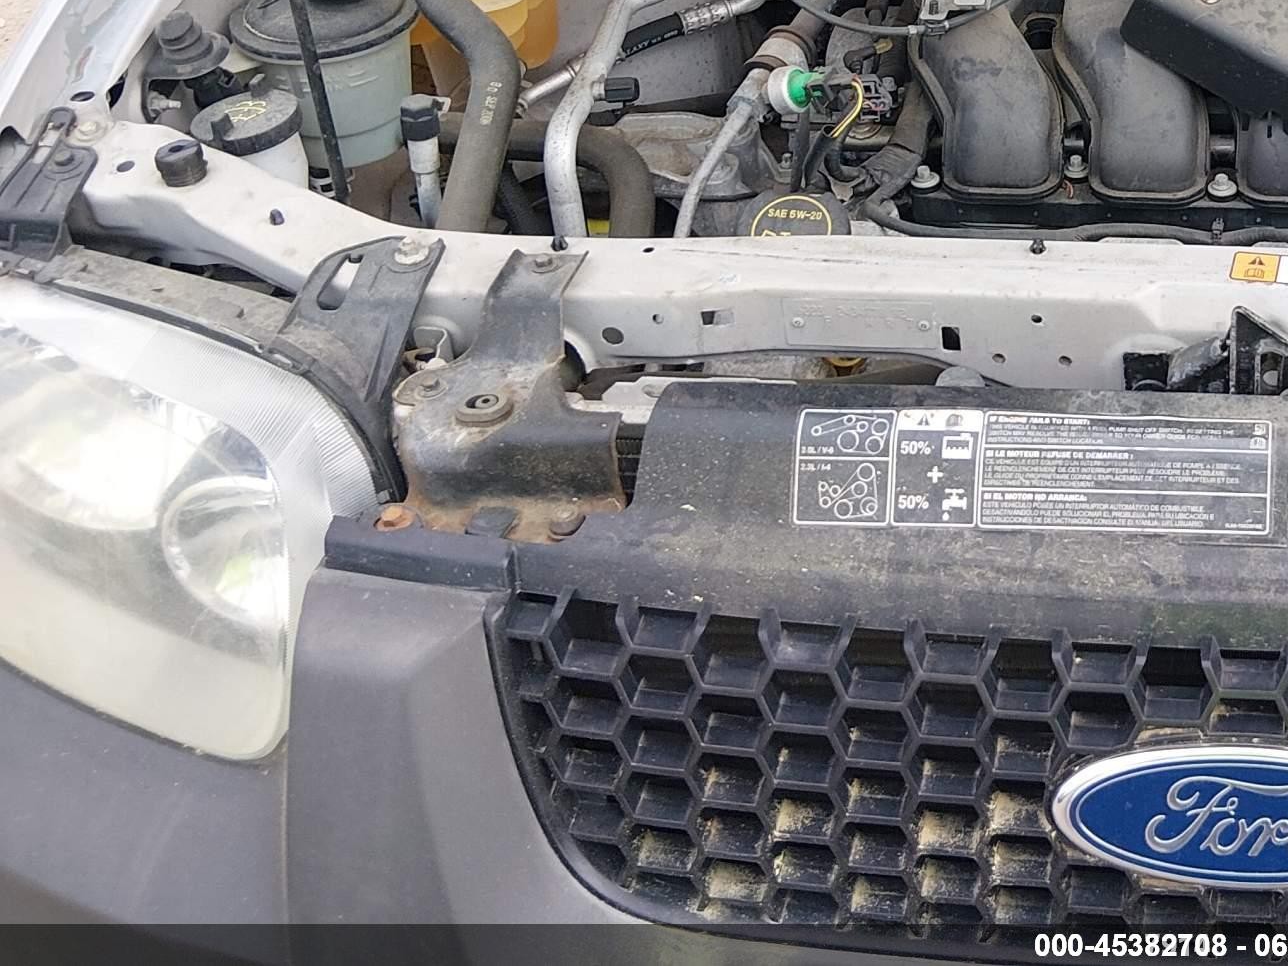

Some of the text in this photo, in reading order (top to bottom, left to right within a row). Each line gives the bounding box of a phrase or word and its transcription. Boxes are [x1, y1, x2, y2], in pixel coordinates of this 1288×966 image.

[767, 208, 823, 221] SAE 5W-20
[900, 440, 930, 456] 50%
[897, 494, 929, 510] 50%
